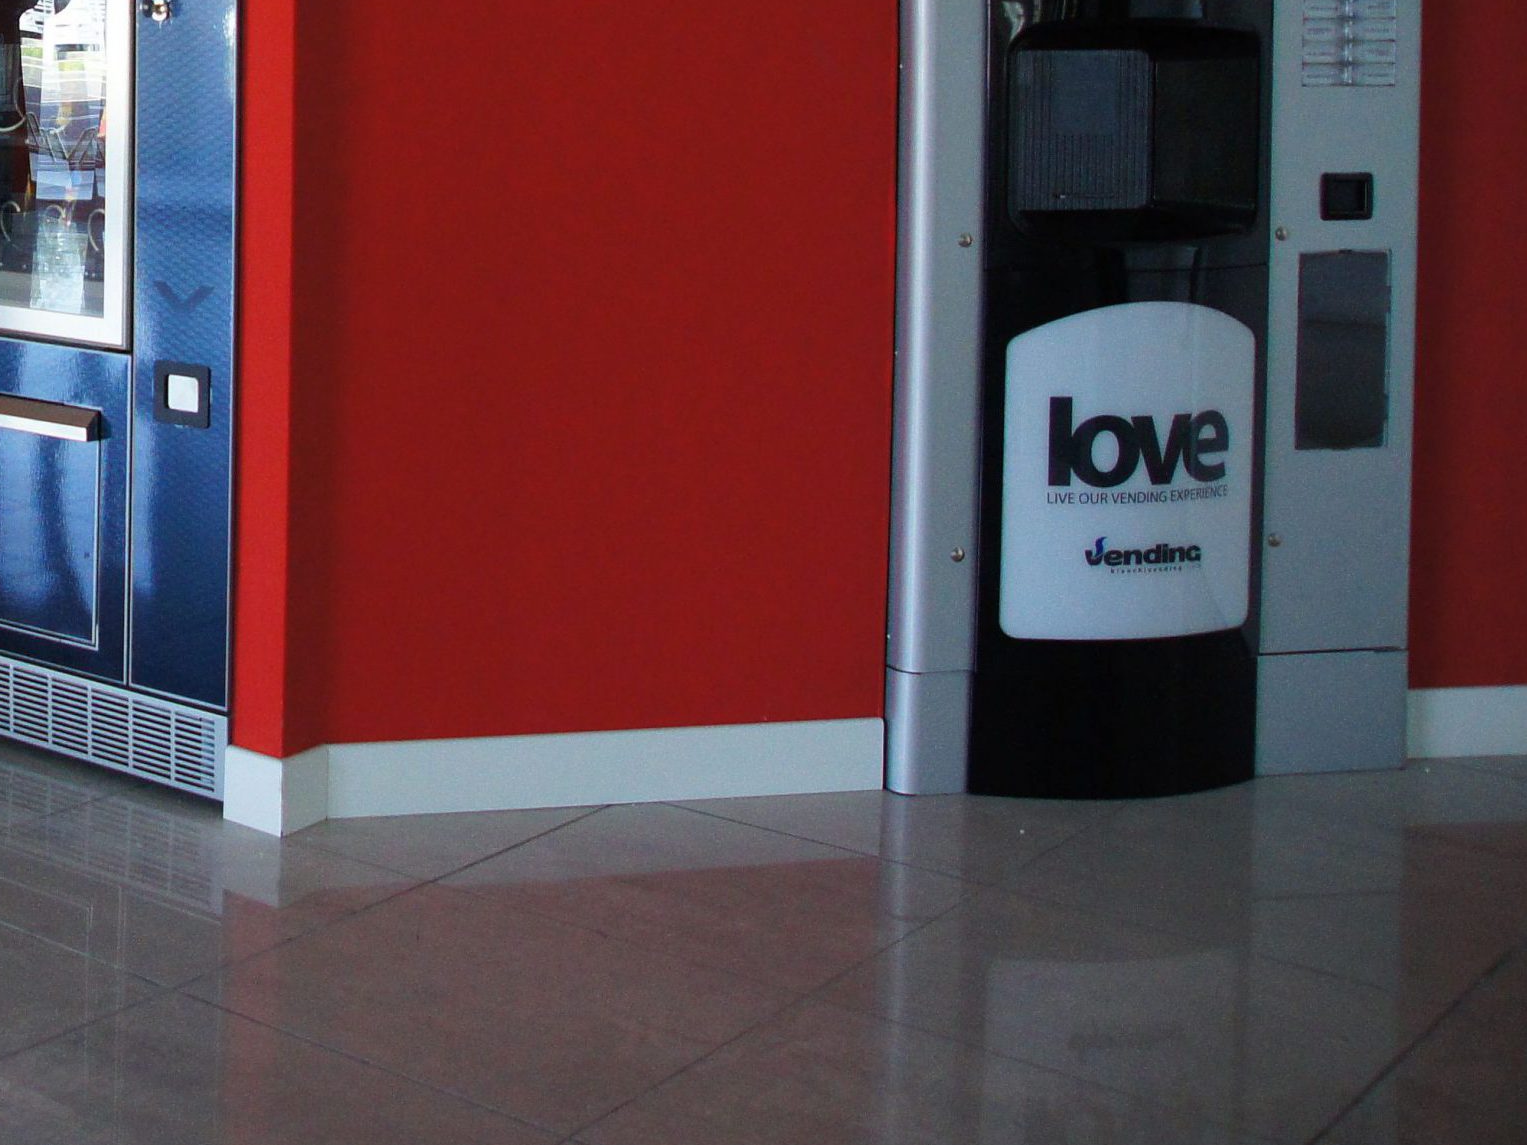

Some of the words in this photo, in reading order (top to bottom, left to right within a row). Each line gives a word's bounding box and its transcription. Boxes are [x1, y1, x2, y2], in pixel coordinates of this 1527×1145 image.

[1047, 396, 1230, 488] love
[1046, 491, 1076, 505] LIVE
[1078, 491, 1109, 505] OUR
[1111, 491, 1168, 505] VENDING
[1170, 483, 1229, 502] EXPERIENCE
